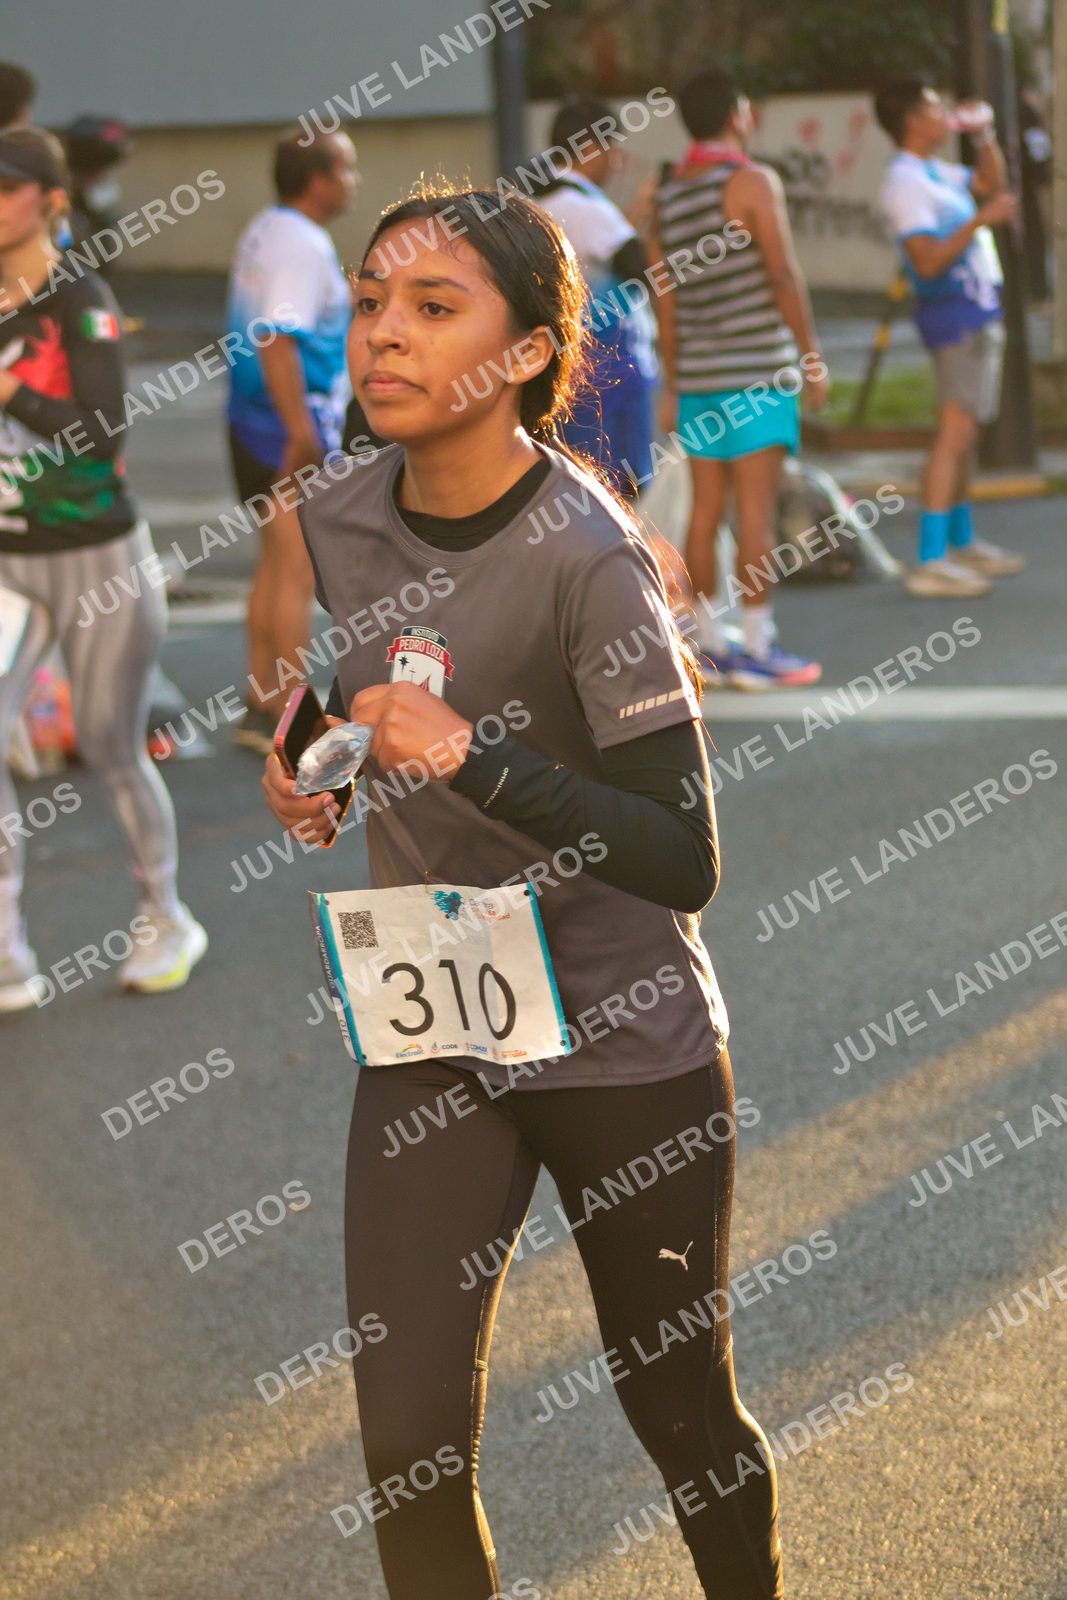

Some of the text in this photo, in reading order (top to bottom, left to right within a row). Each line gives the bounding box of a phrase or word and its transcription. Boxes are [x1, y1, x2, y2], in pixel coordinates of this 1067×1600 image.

[399, 639, 445, 663] PEDRO LOZA
[381, 959, 516, 1040] 310
